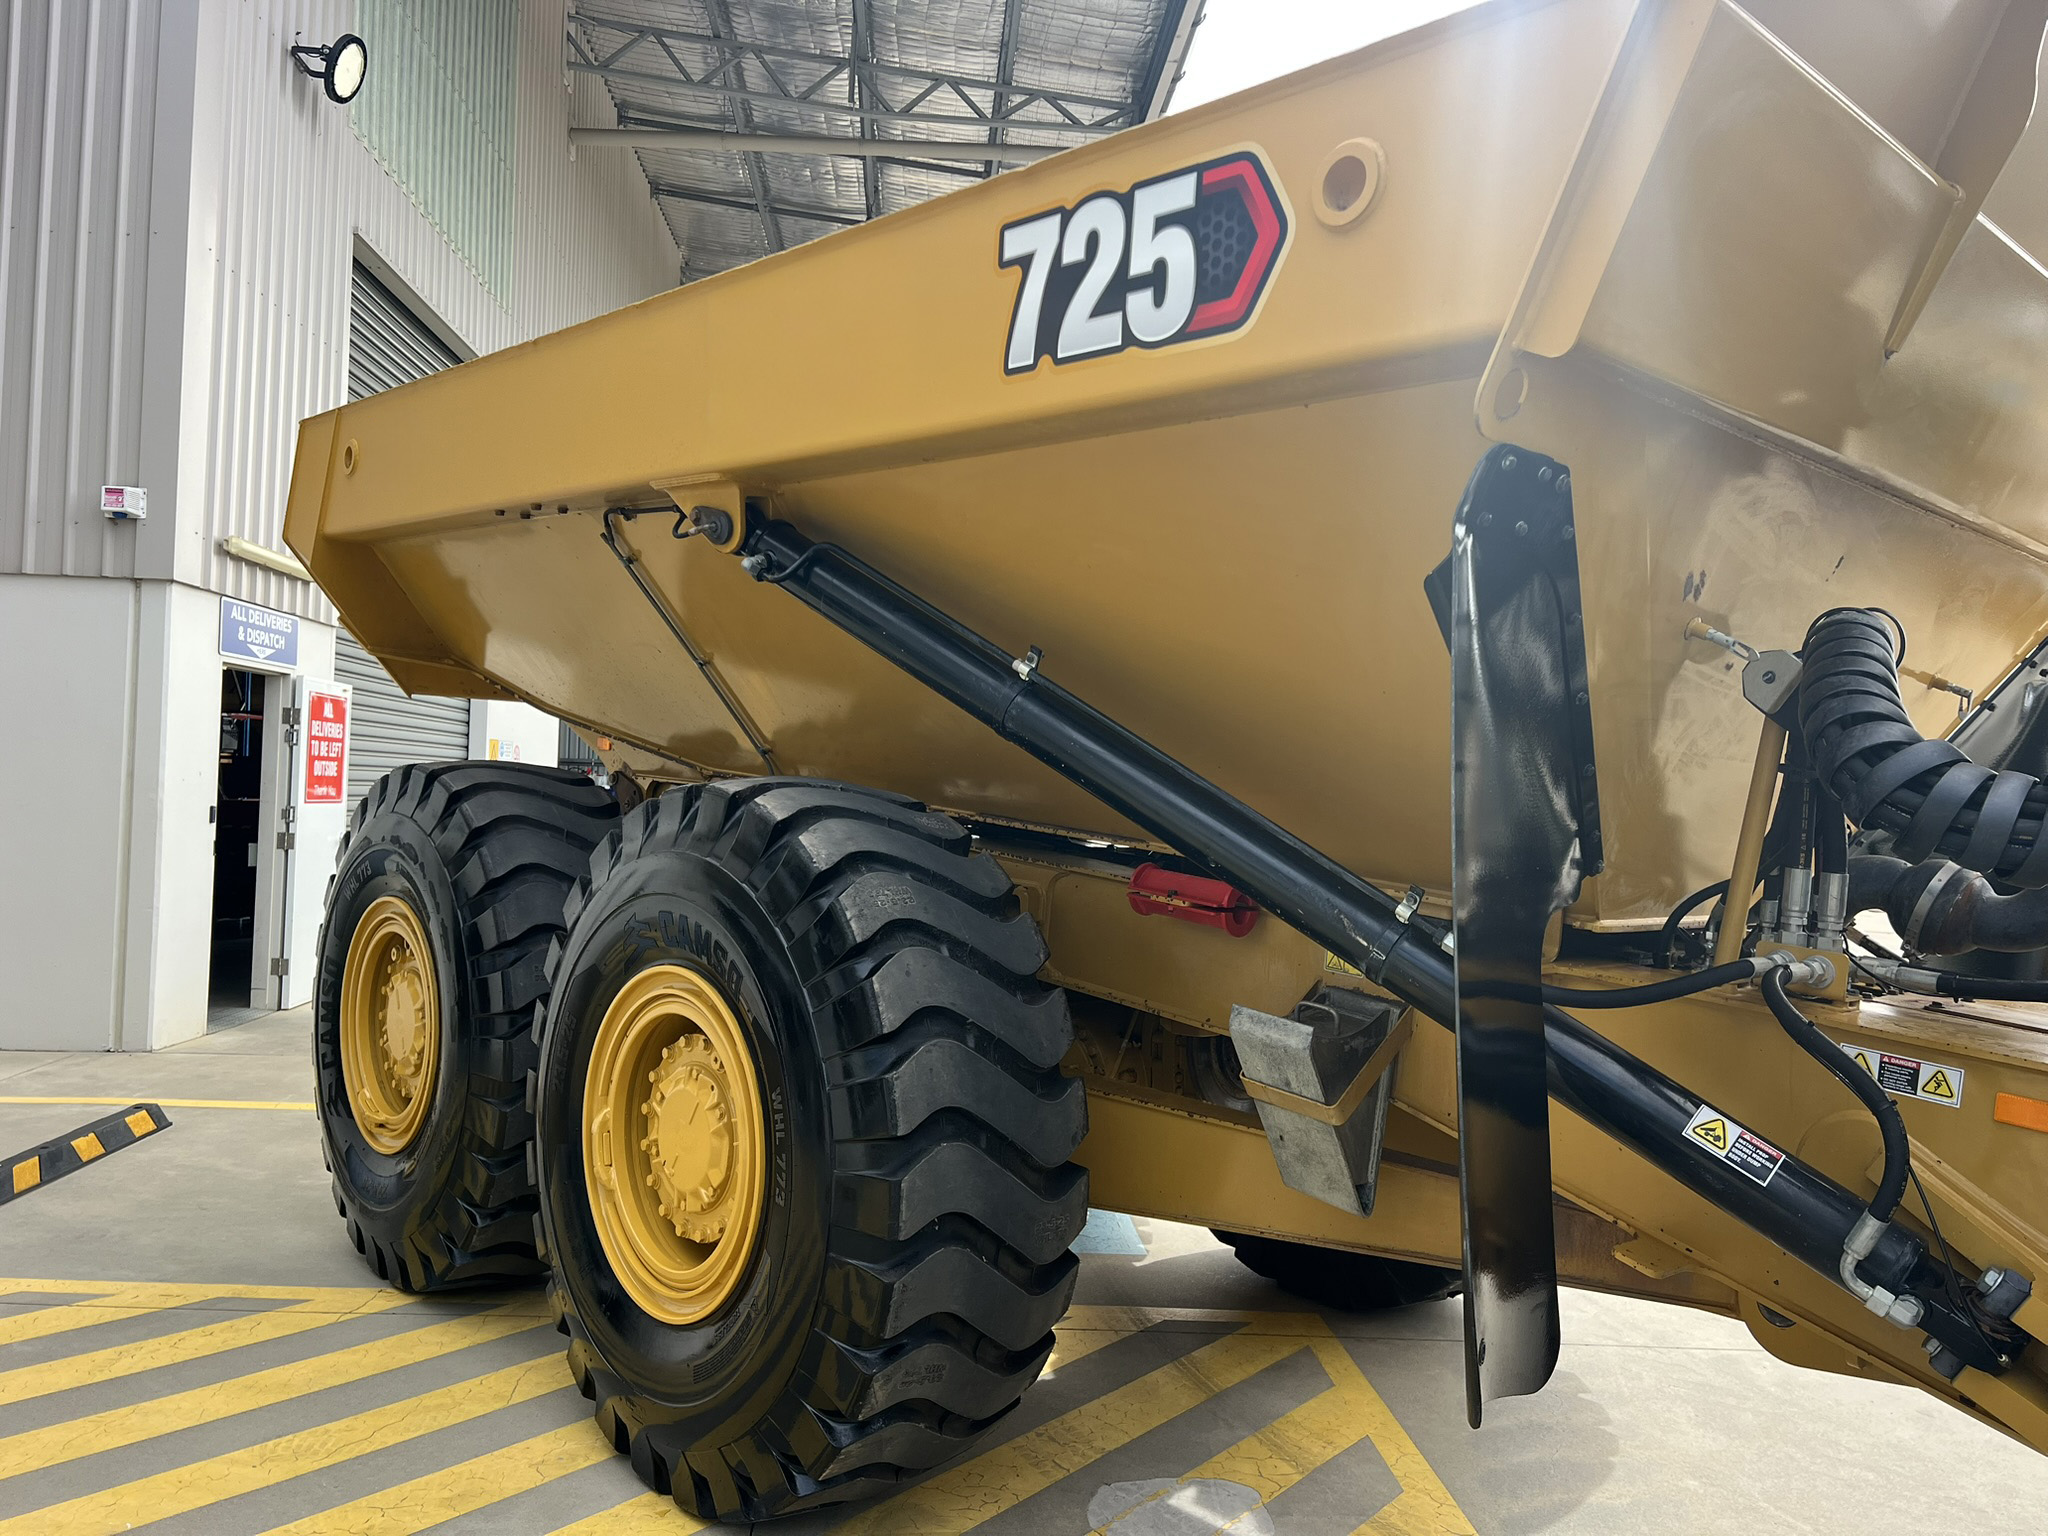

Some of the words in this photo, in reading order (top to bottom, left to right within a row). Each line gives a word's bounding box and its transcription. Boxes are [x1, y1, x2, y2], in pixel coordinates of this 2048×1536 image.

[1002, 171, 1197, 369] 725
[230, 605, 247, 622] ALL
[248, 609, 292, 633] DELIVERIES
[238, 625, 245, 641] &
[246, 627, 285, 650] DISPATCH
[323, 702, 334, 719] ALL
[311, 720, 344, 739] DELIVERIES
[311, 740, 320, 757] TO
[320, 741, 328, 757] BE
[329, 742, 343, 758] LEFT
[313, 760, 338, 777] OUTSIDE
[343, 876, 359, 901] WHL
[357, 860, 372, 882] 773
[658, 910, 744, 1004] CAMSO
[1890, 1057, 1917, 1068] DANGER
[771, 1086, 785, 1145] WHL
[1734, 1142, 1753, 1156] BEFORE
[1737, 1137, 1756, 1152] INSTALL
[1751, 1138, 1777, 1156] DANGER
[775, 1153, 787, 1207] 773
